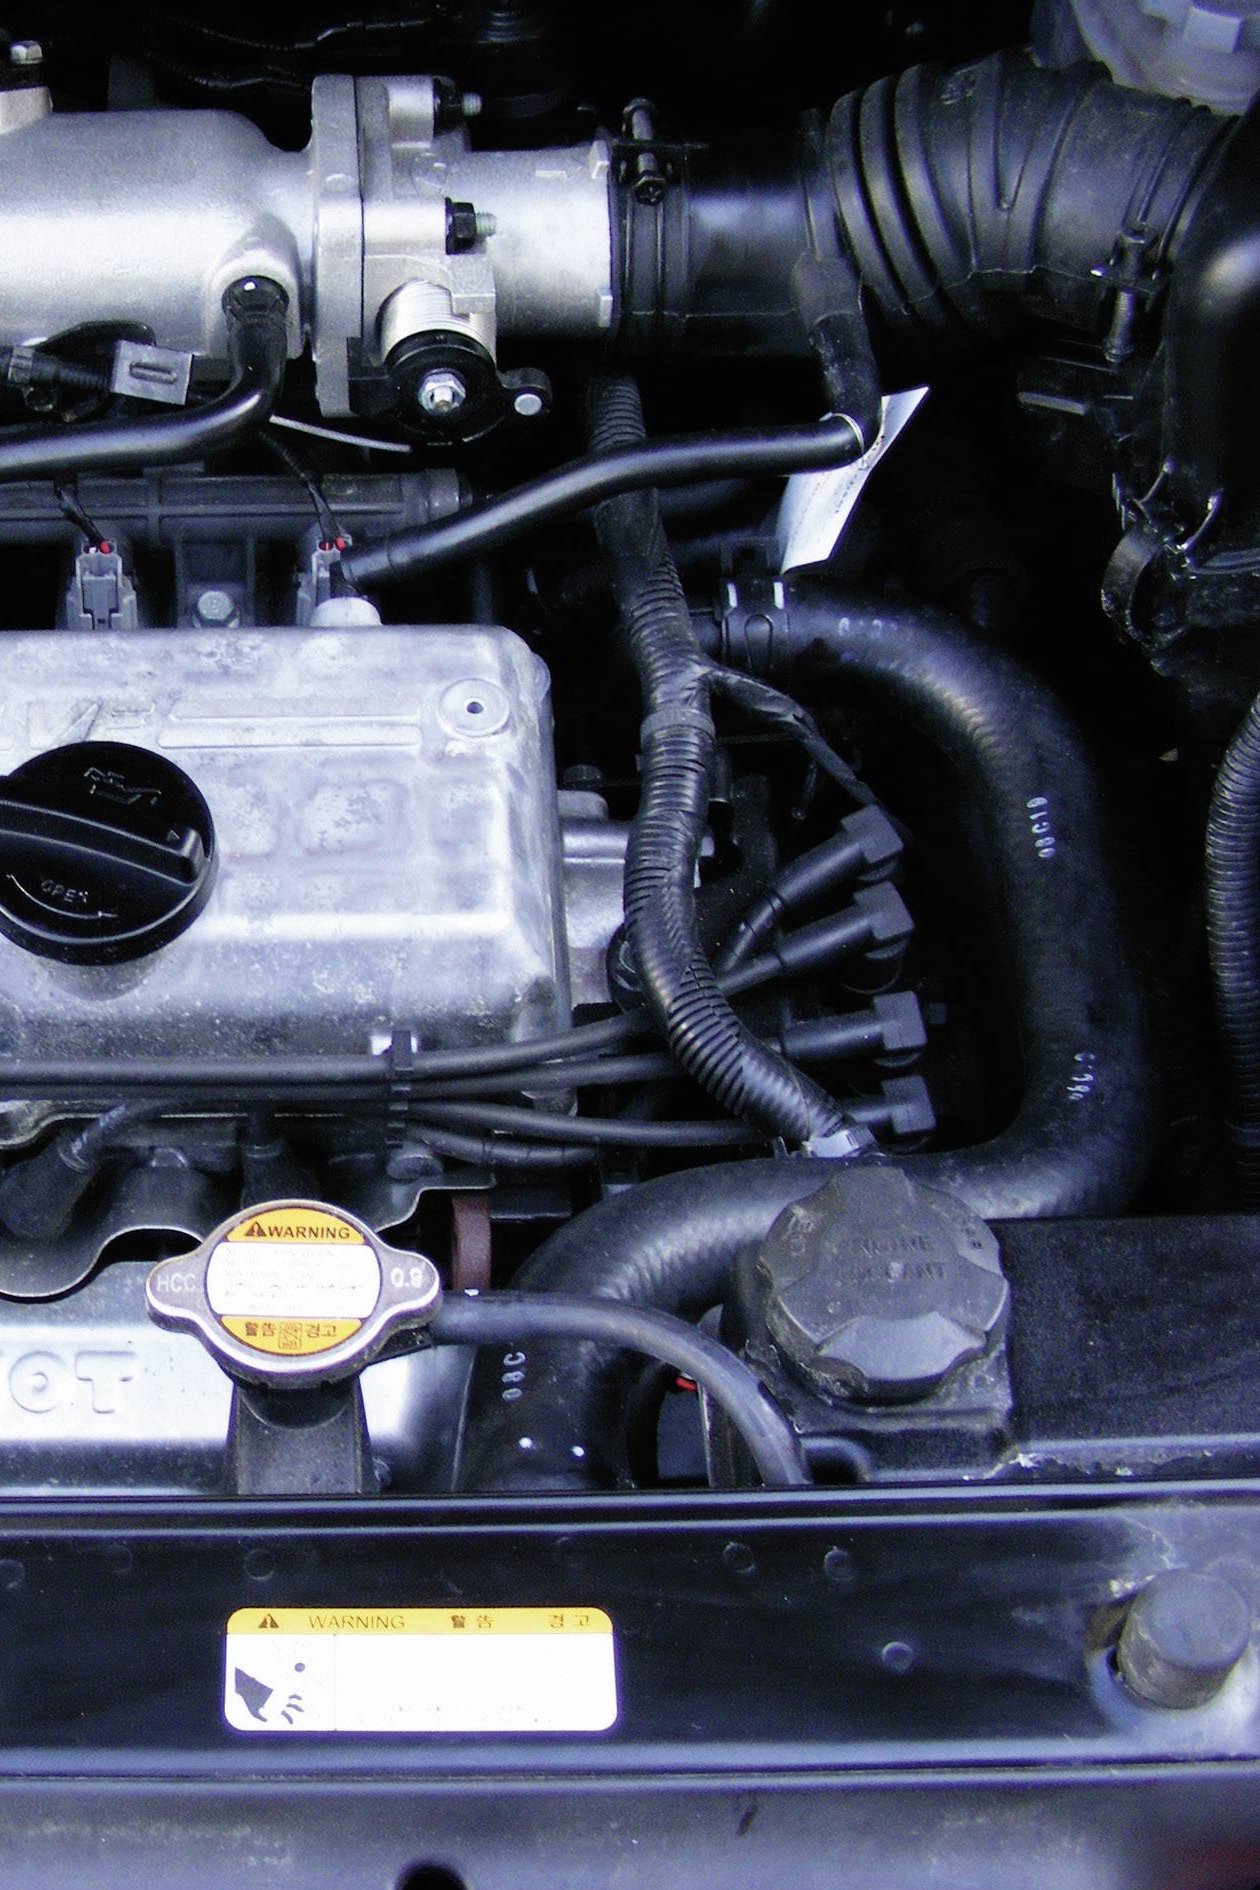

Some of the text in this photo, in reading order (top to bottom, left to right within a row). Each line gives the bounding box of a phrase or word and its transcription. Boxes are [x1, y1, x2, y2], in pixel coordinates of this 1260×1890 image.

[268, 1225, 351, 1240] WARNING
[156, 1274, 197, 1293] HCC
[390, 1267, 424, 1288] 0.9
[308, 1614, 405, 1630] WARNING
